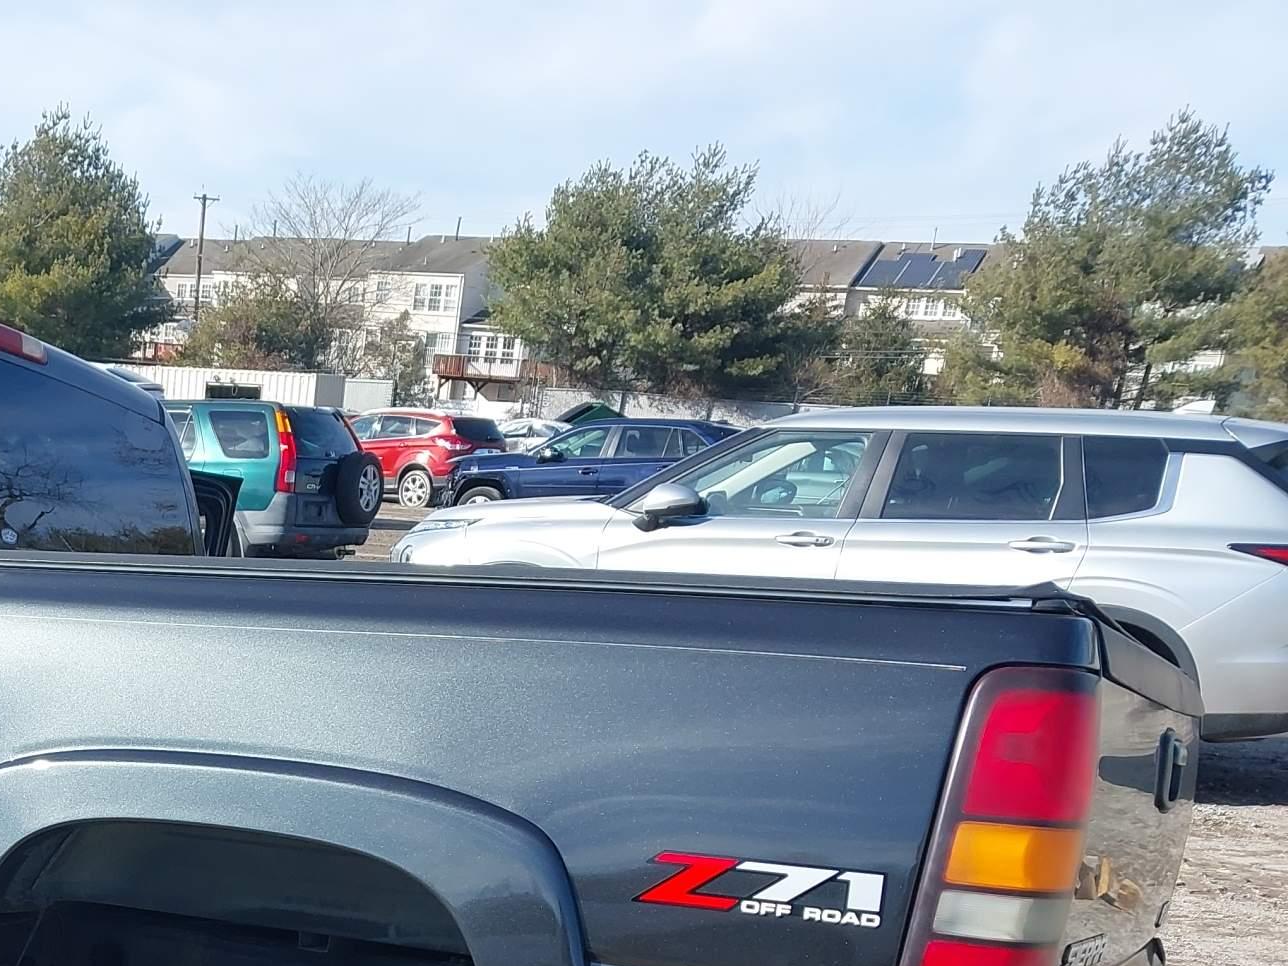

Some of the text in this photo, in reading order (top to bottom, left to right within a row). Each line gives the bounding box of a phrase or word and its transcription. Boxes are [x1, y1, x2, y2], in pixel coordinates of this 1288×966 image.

[634, 850, 886, 912] Z71
[740, 899, 881, 928] OFF ROAD
